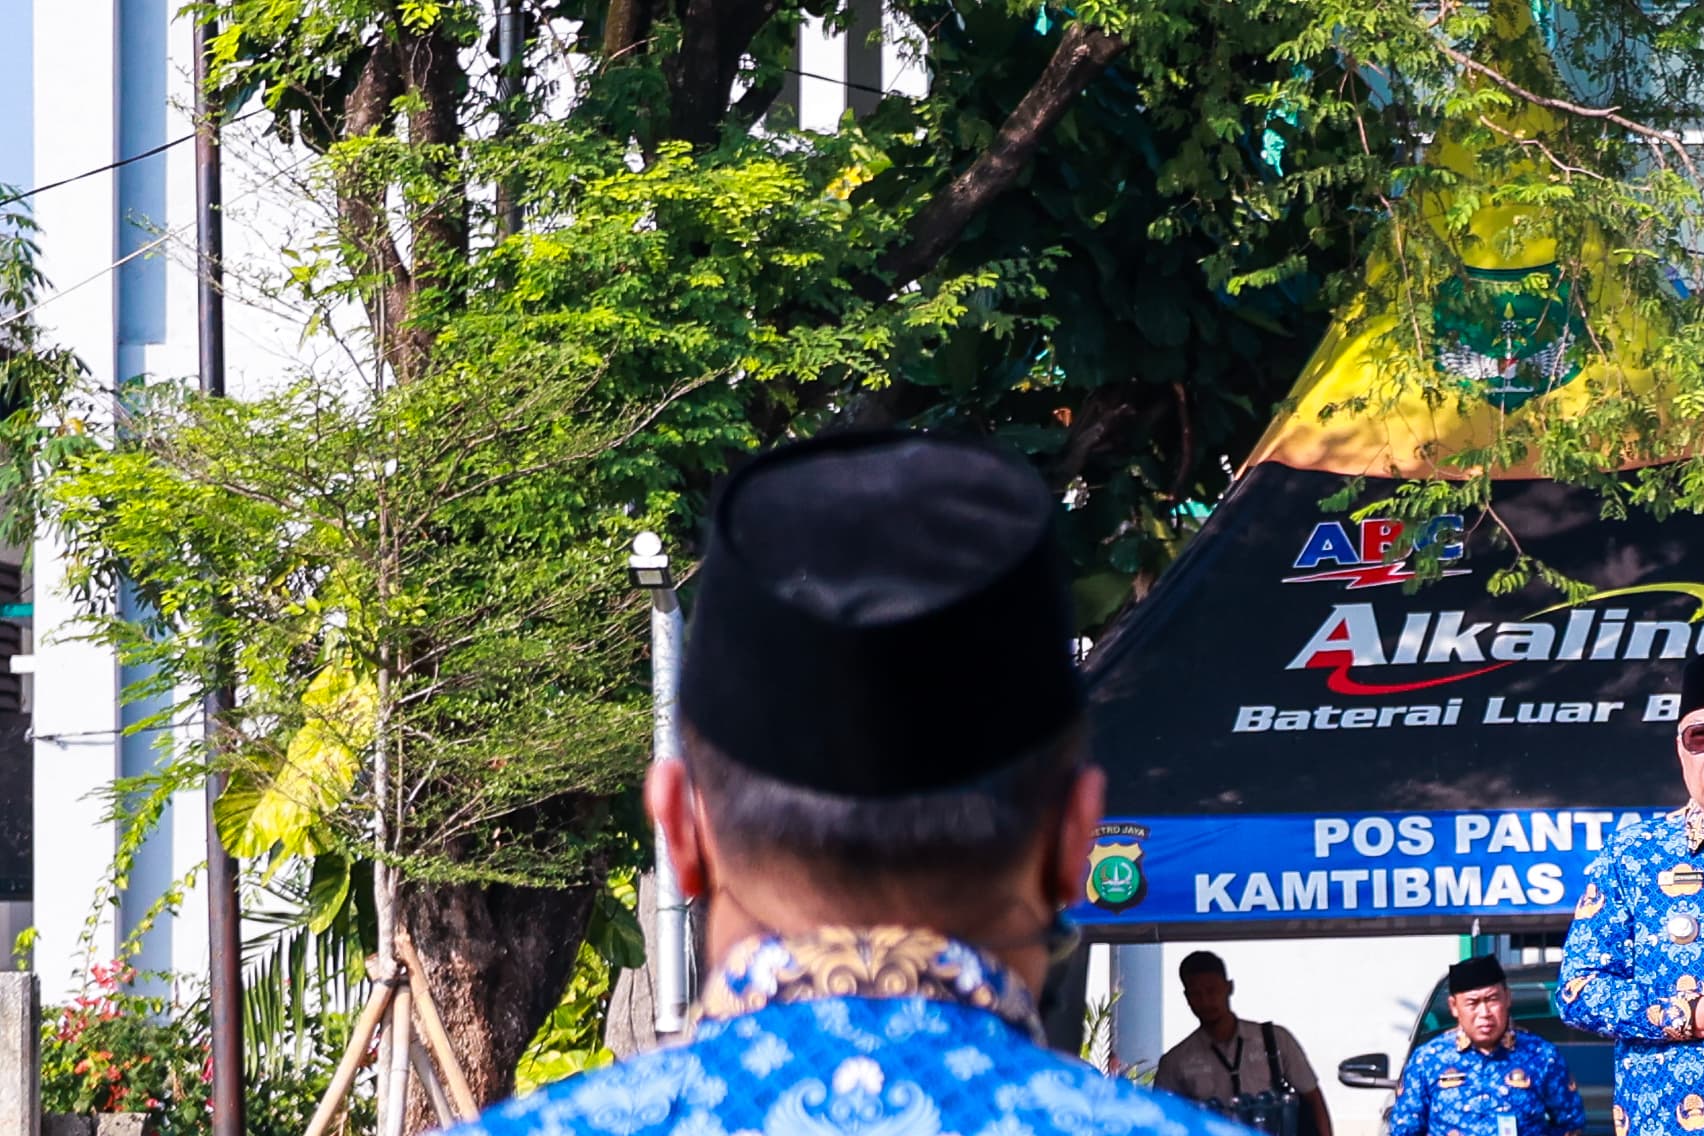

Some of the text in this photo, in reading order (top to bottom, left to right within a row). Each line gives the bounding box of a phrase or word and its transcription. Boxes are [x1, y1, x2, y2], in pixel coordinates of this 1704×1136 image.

[1293, 514, 1464, 568] ABC
[1232, 698, 1462, 733] Baterai
[1482, 698, 1624, 725] Luar
[1121, 825, 1145, 837] JAYA
[1314, 811, 1667, 858] POS PANT
[1195, 863, 1565, 913] KAMTIBMAS
